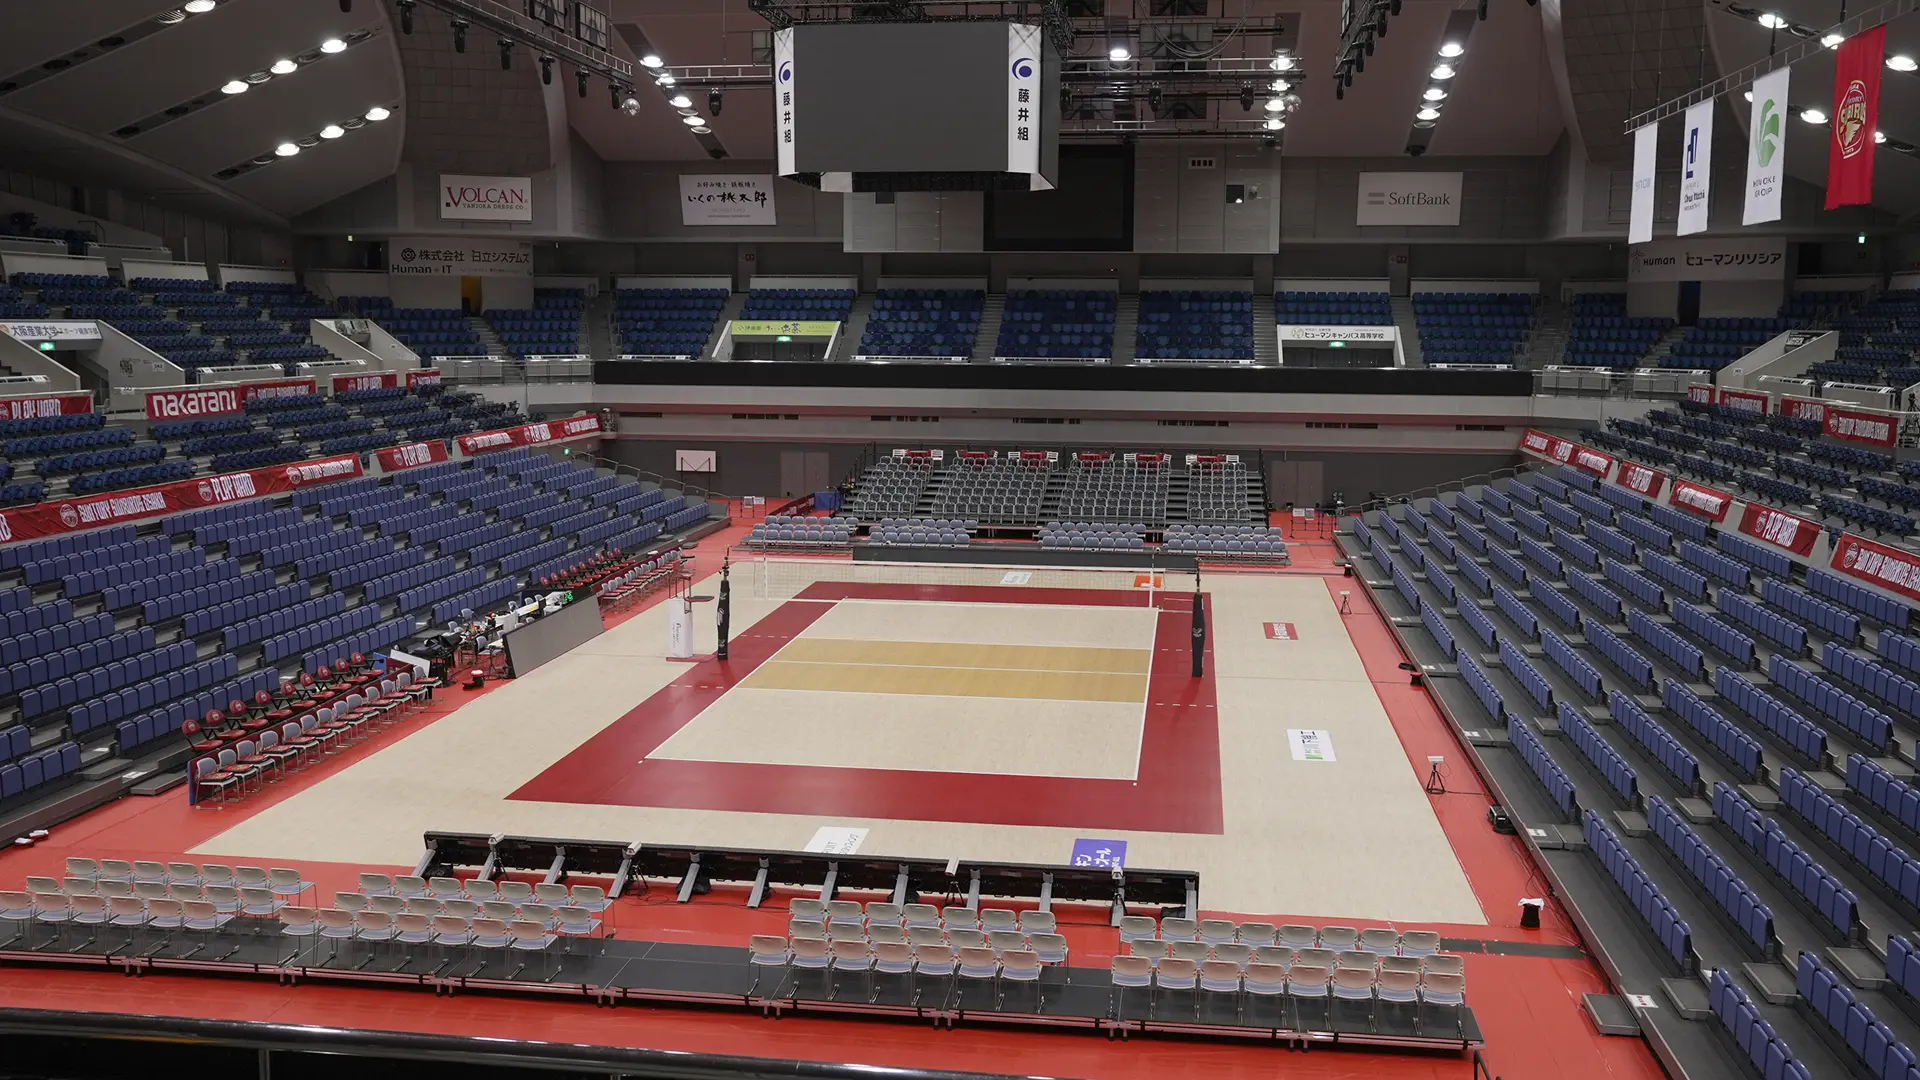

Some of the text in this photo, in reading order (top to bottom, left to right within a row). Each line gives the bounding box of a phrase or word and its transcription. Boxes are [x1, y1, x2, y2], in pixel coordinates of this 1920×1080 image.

[783, 91, 791, 143] 藤井組
[1017, 88, 1029, 141] 藤井組
[446, 186, 524, 208] VOLCAN
[1388, 191, 1451, 206] SoftBank
[418, 249, 530, 264] 株式会社 日立システムズ
[1685, 252, 1782, 266] ヒューマンリソシア
[391, 264, 432, 274] Human
[442, 265, 453, 274] IT
